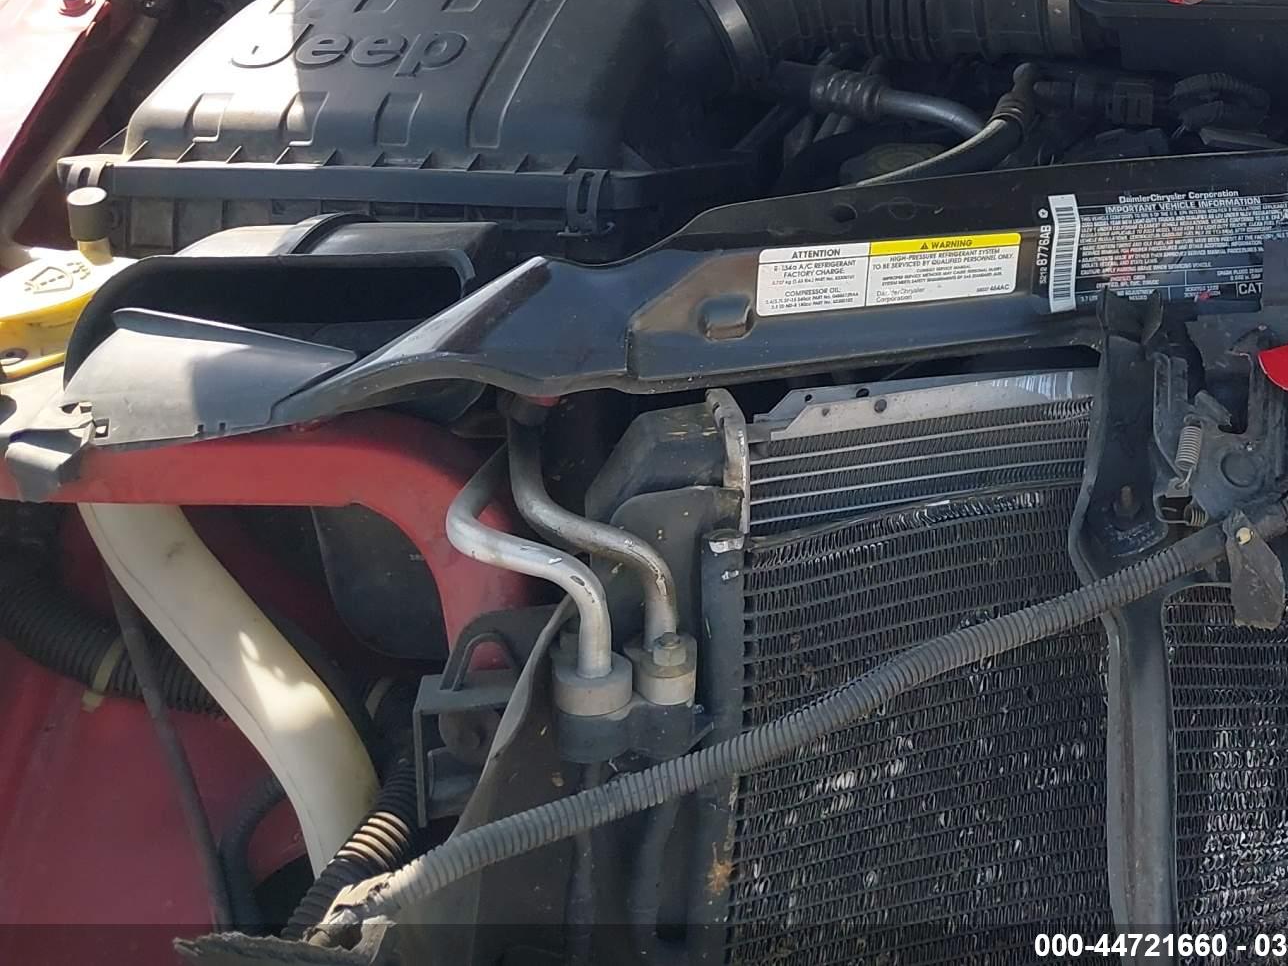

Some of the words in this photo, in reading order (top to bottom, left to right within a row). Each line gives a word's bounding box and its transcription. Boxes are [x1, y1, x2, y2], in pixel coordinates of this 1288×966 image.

[231, 22, 469, 78] Jeep
[1119, 192, 1187, 203] DaimlerChrysler
[1188, 190, 1239, 200] Corporation
[1105, 203, 1156, 213] IMPORTANT
[1158, 200, 1196, 209] VEHICLE
[1198, 196, 1260, 208] INFORMATION
[931, 239, 973, 250] WARNING
[1036, 224, 1052, 266] 8776AB
[791, 249, 840, 259] ATTENTION
[876, 295, 913, 303] Corporation
